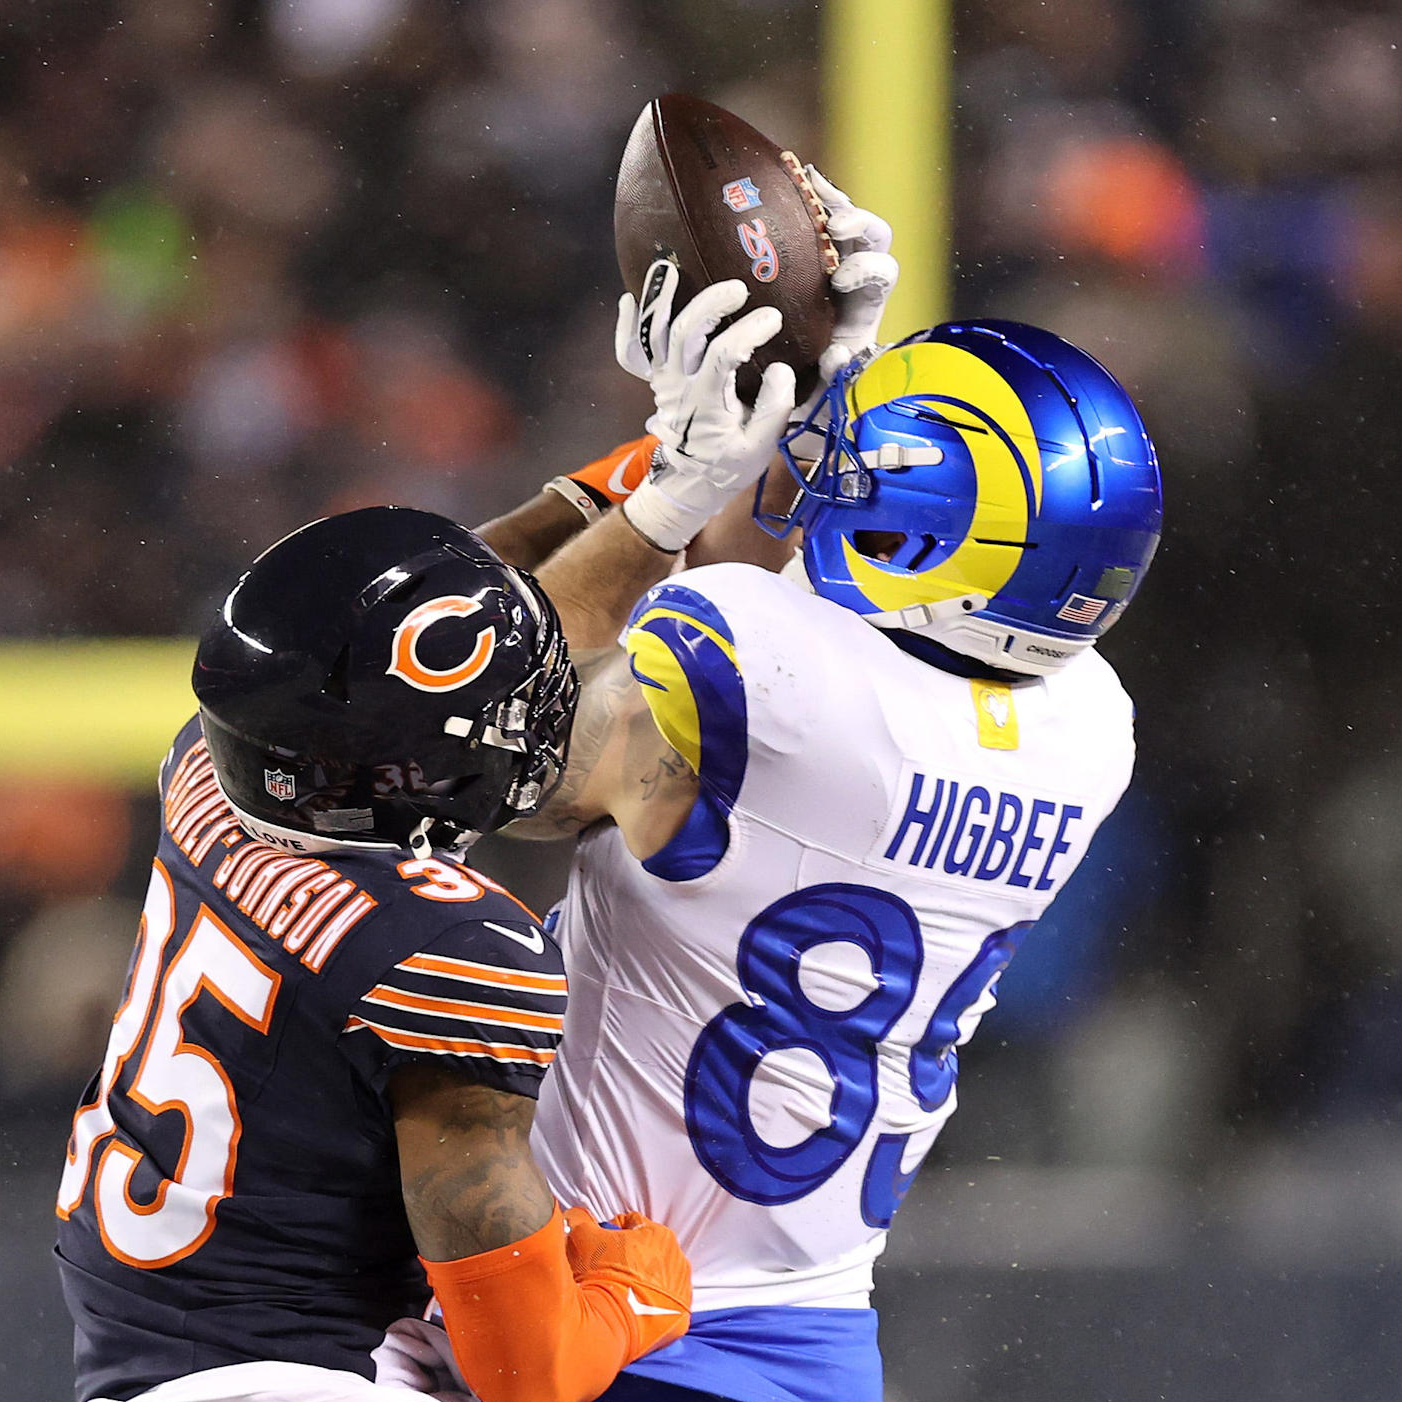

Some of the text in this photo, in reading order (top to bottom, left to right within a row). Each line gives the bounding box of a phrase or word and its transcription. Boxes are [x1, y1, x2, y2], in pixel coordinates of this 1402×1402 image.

[726, 184, 748, 209] NFL
[385, 595, 496, 693] C
[268, 781, 293, 798] NFL
[883, 772, 1084, 891] HIGBEE
[396, 857, 523, 903] 3
